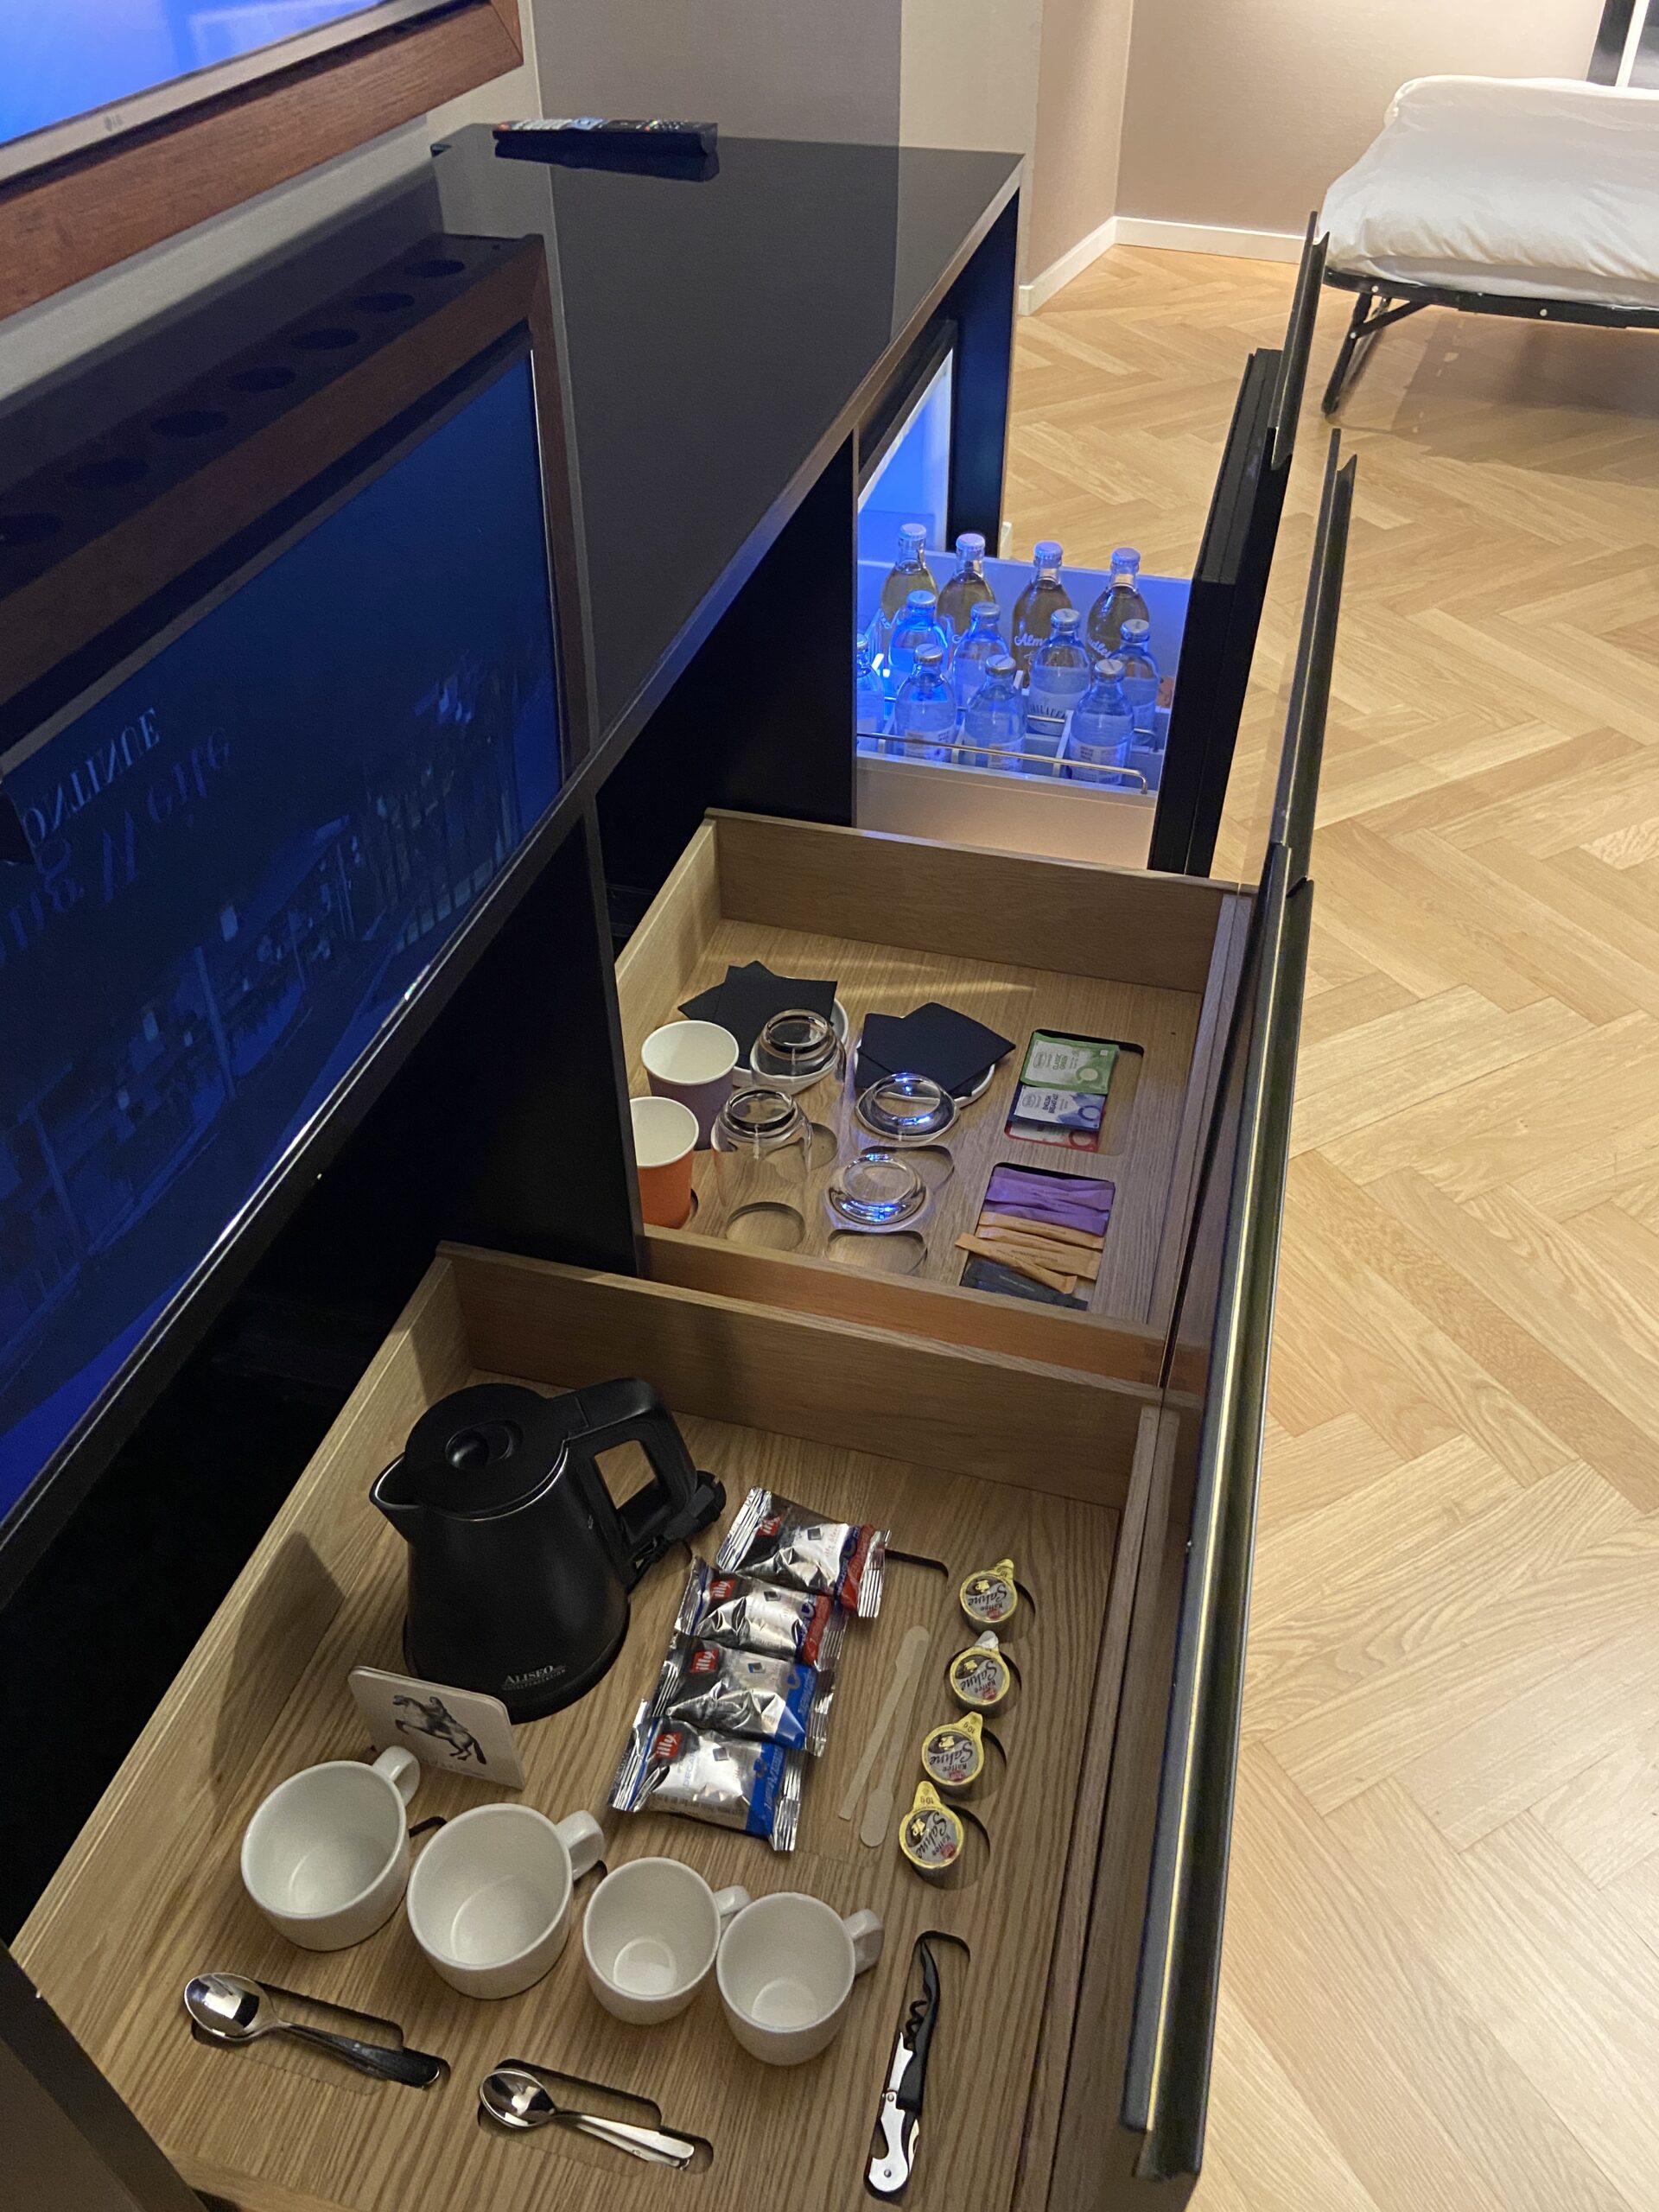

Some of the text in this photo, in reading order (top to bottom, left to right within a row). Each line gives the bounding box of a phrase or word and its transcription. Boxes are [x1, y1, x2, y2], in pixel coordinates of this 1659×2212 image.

[712, 1580, 731, 1598] illy
[967, 1584, 1007, 1606] Sahne
[695, 1649, 715, 1671] illy
[959, 1660, 997, 1691] Sahne
[656, 1733, 677, 1757] illy
[929, 1740, 973, 1766] Sahne
[941, 1762, 967, 1772] Kaffee
[915, 1811, 948, 1860] Sahne
[931, 1833, 951, 1857] Kaffee
